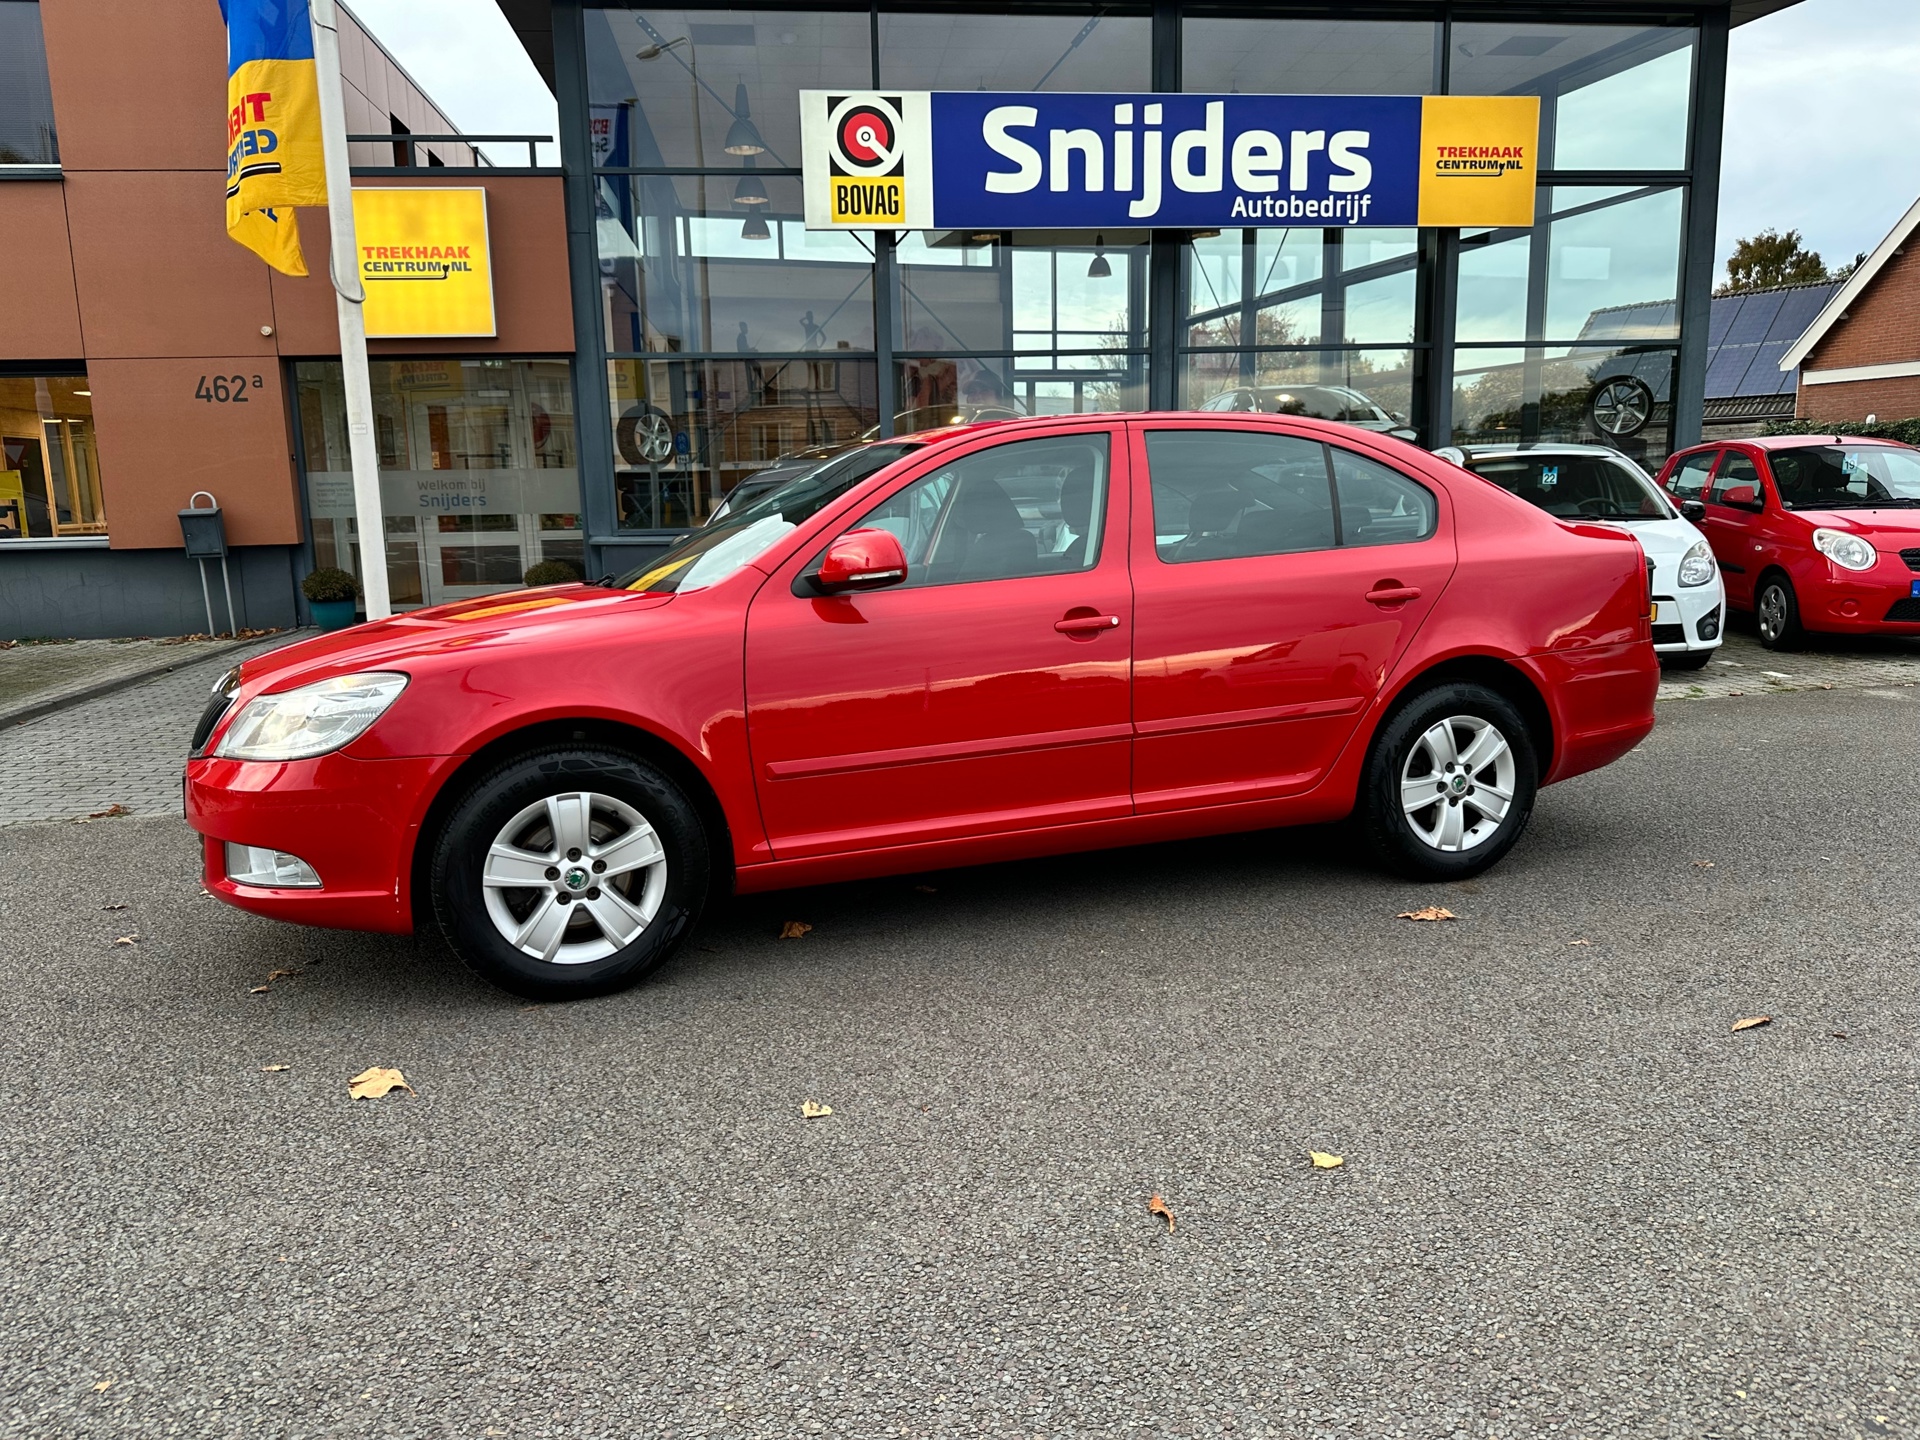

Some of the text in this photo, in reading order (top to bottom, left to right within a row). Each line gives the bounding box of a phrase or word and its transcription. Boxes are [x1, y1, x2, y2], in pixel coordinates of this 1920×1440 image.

[1436, 146, 1524, 158] TREKHAAK
[983, 101, 1372, 219] Snijders
[837, 184, 900, 217] BOVAG
[1230, 193, 1372, 224] Autobedrijf
[362, 246, 471, 259] TREKHAAK
[1845, 460, 1855, 470] 19
[417, 478, 486, 493] Welkom bij
[1543, 473, 1556, 484] 22
[419, 493, 487, 511] Snijders
